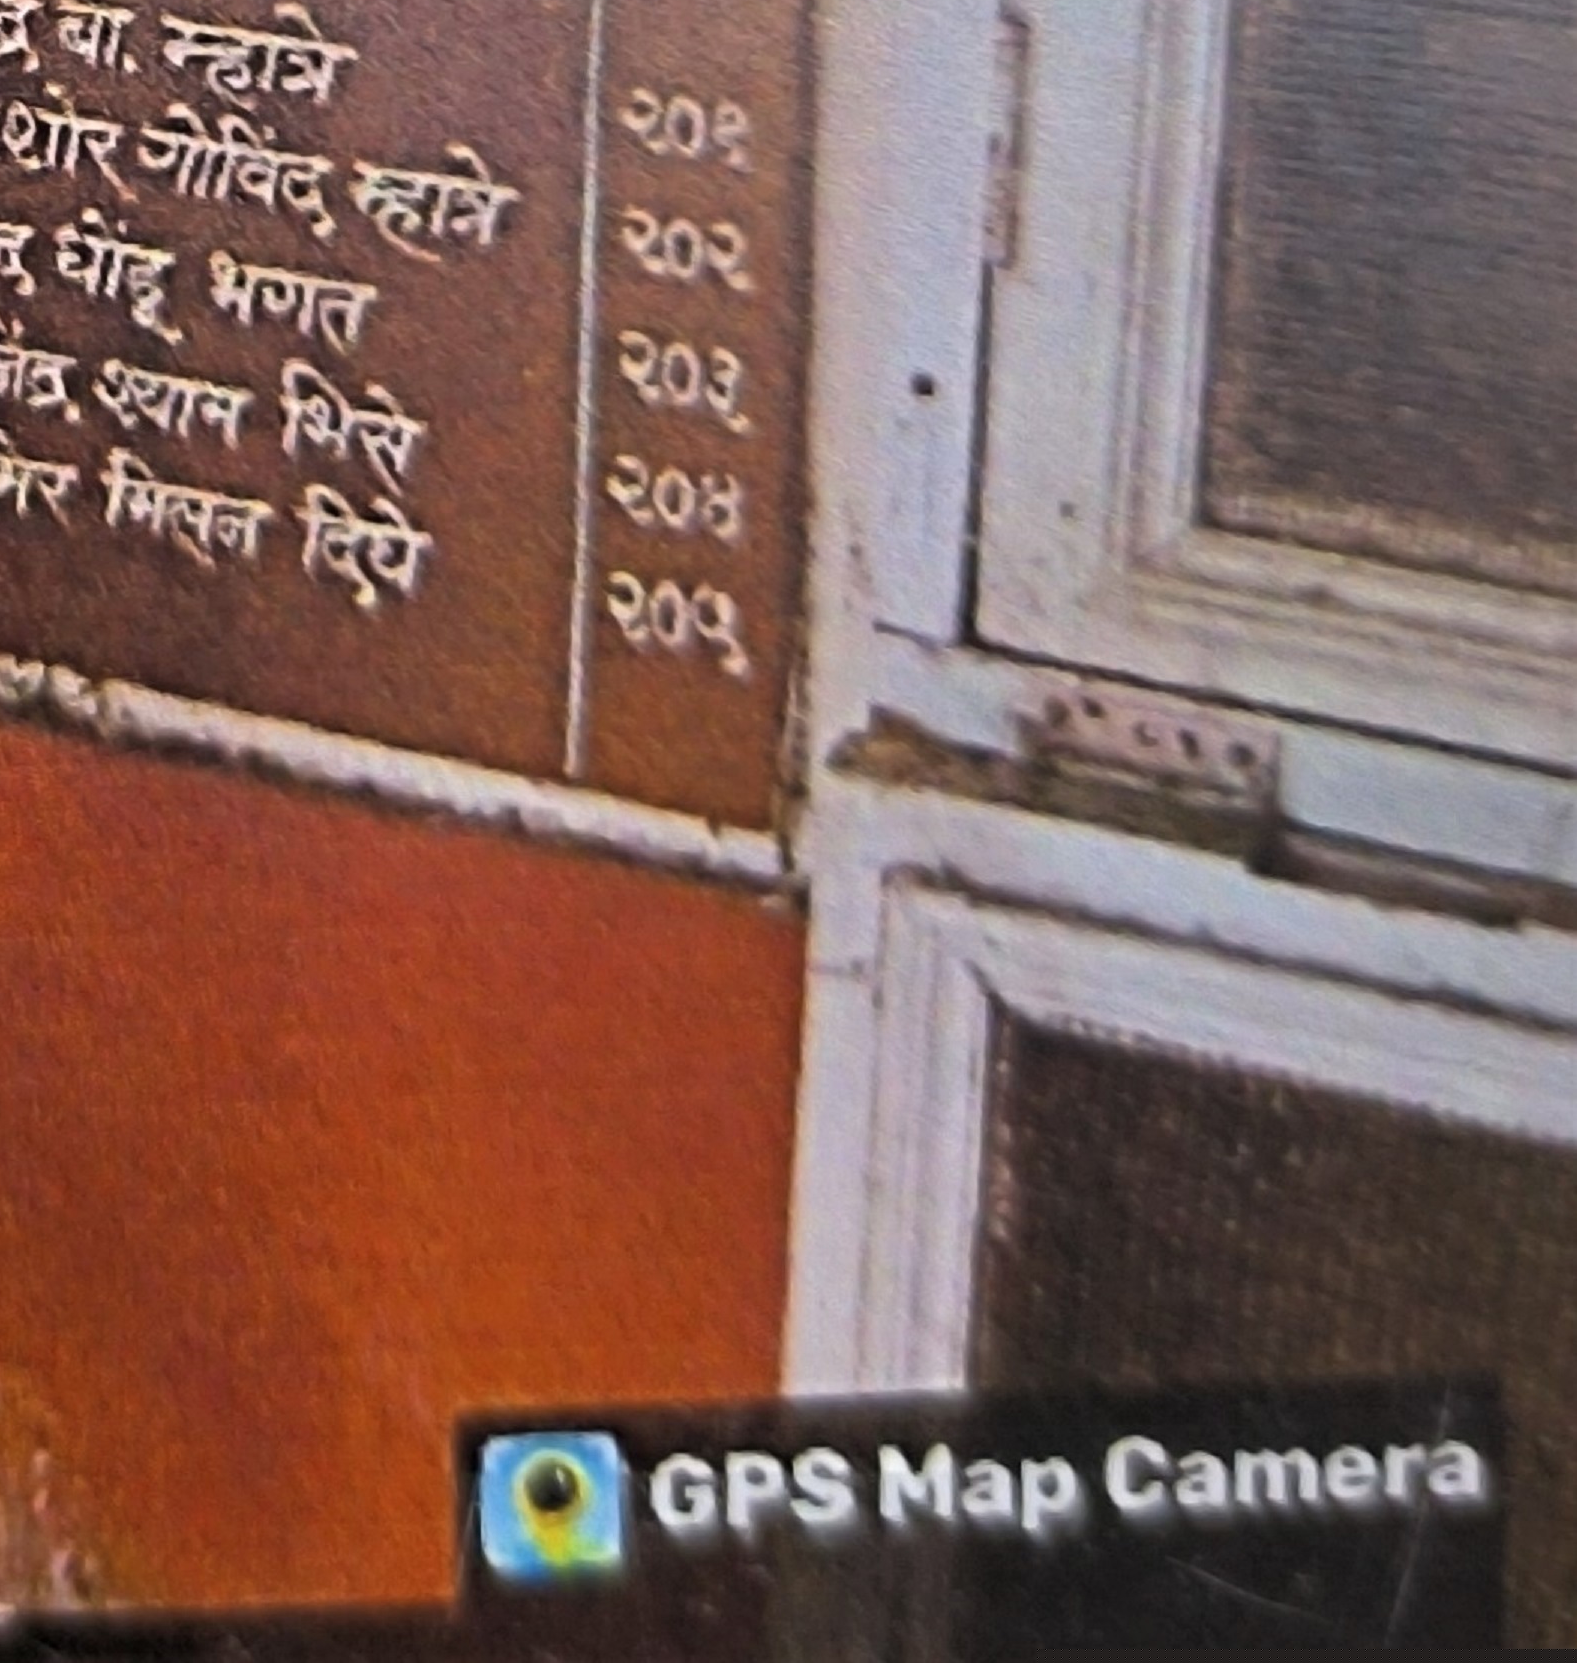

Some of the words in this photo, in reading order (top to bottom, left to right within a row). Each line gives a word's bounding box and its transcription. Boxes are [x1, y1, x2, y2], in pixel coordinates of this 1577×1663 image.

[159, 1, 361, 113] म्हात्रे
[137, 101, 335, 243] गोविंद
[353, 141, 525, 265] म्हात्रे
[207, 247, 381, 355] भगत
[617, 329, 753, 437] २०३
